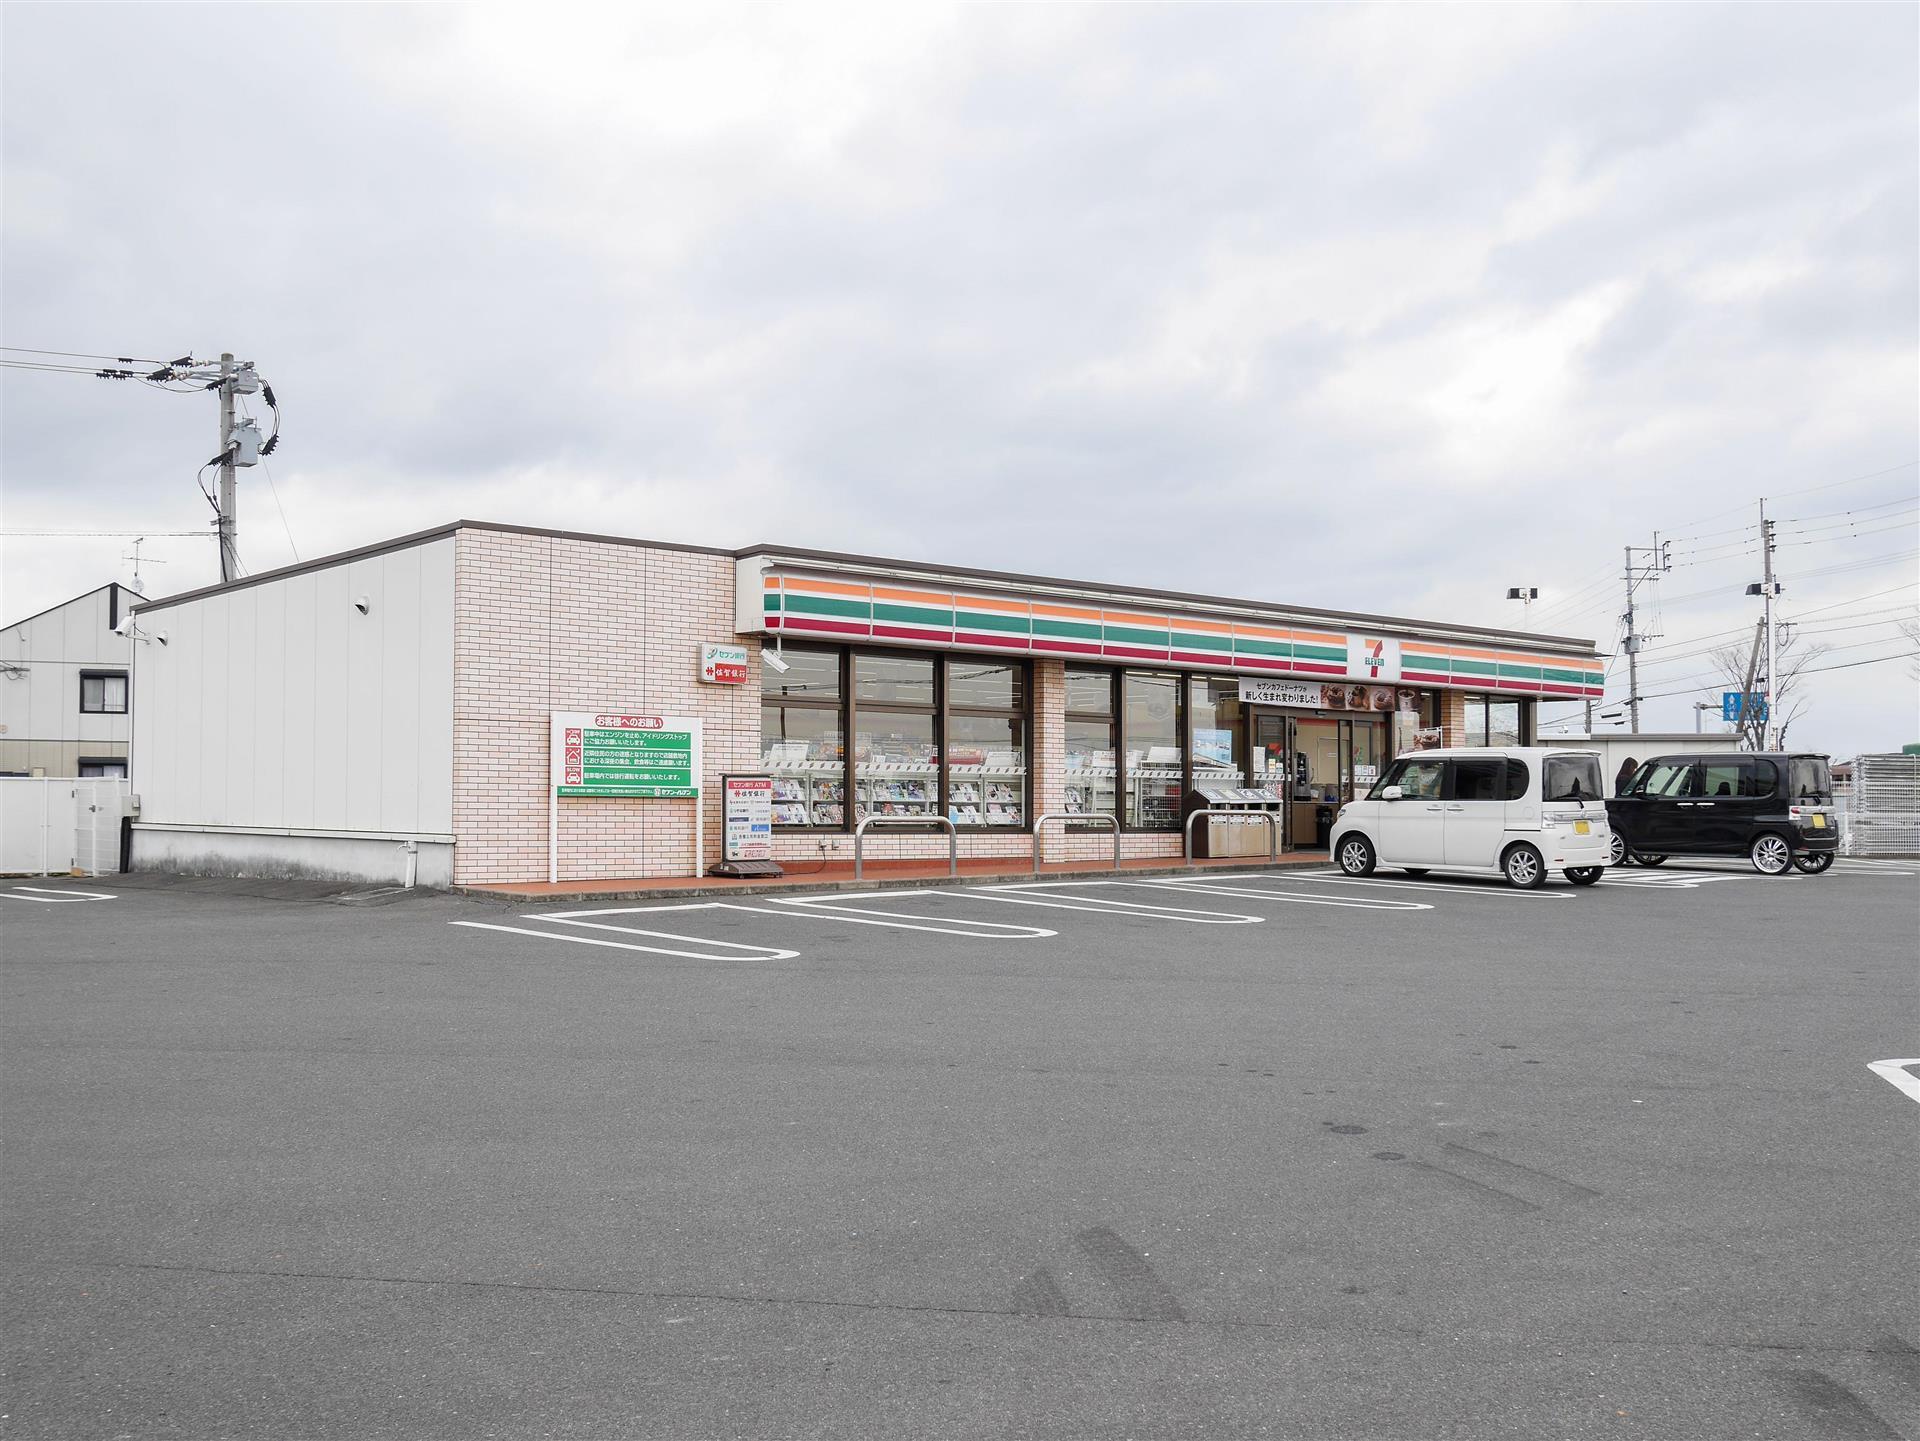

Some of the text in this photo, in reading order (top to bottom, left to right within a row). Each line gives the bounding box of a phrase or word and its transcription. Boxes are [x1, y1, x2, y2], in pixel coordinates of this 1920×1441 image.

[1365, 639, 1383, 677] 7
[715, 668, 746, 678] 佐賀銀行
[596, 716, 662, 728] お客様へのお願い
